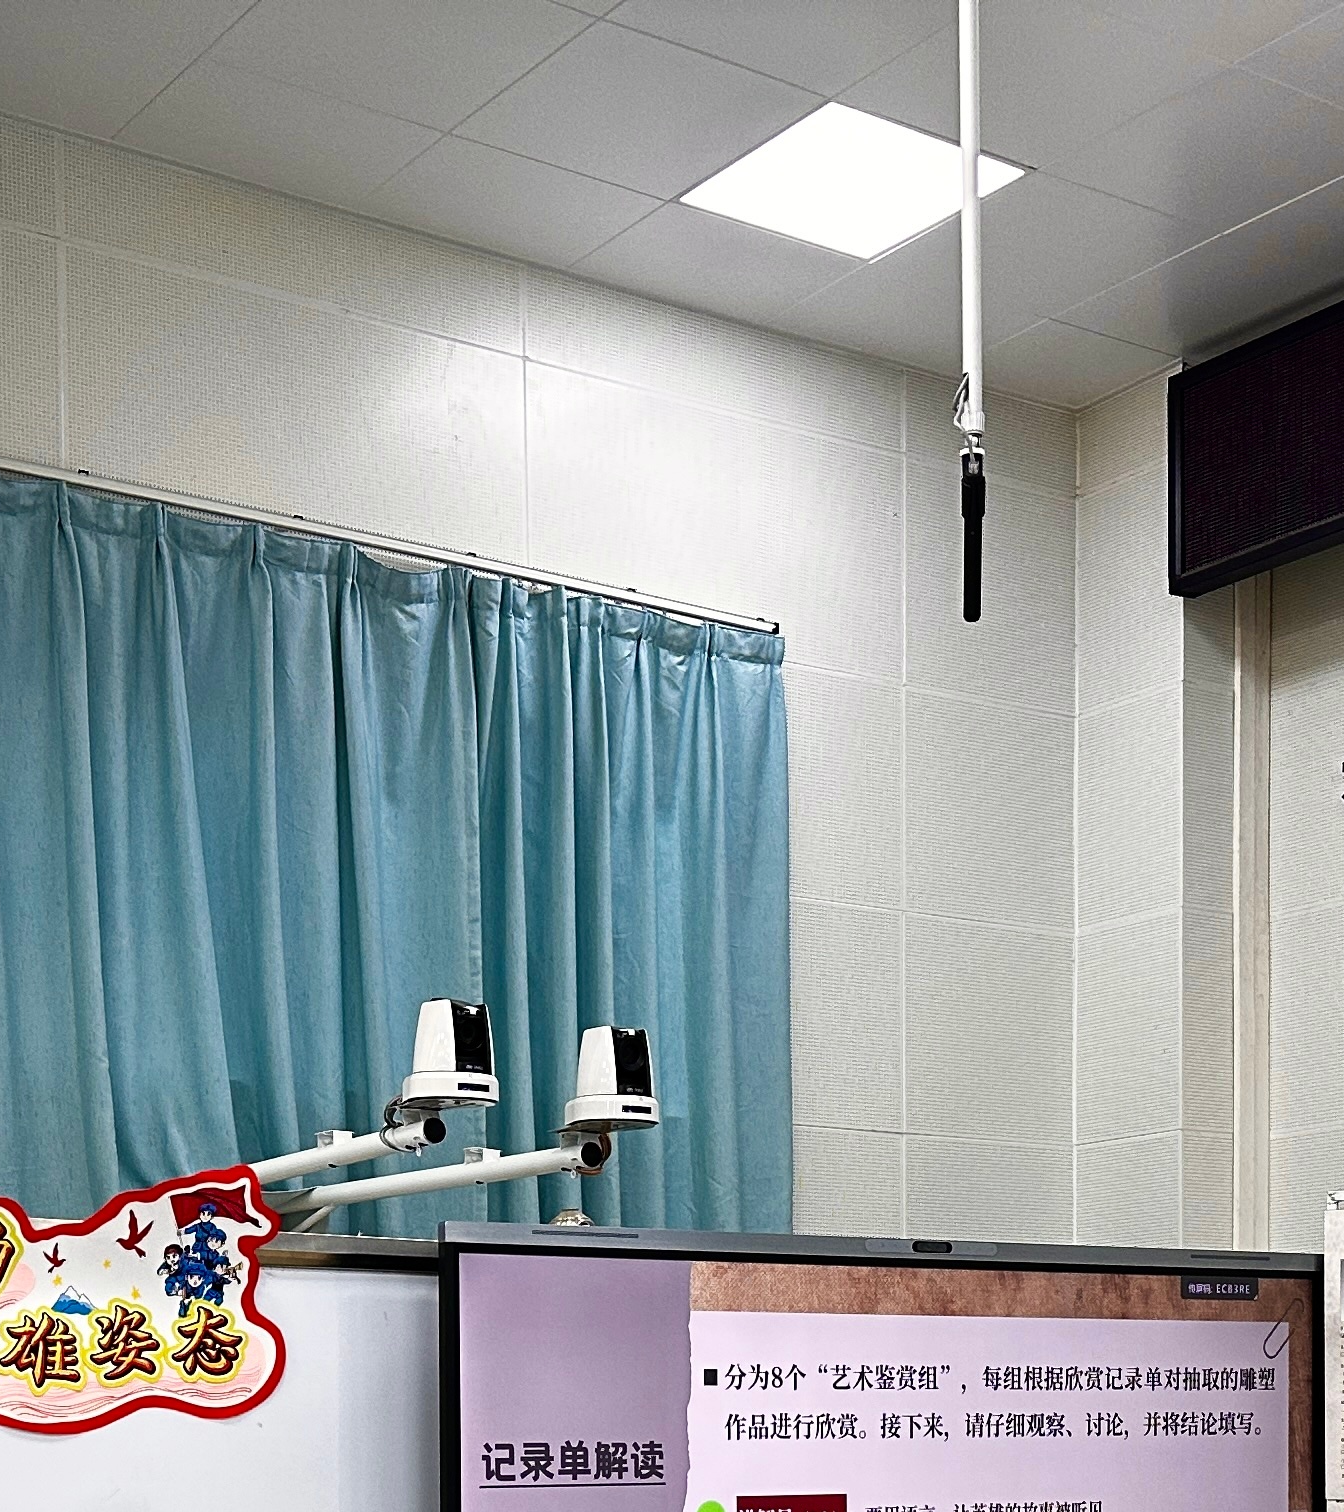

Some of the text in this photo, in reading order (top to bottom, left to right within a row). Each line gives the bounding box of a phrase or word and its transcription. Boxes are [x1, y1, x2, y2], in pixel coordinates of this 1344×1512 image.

[482, 1440, 665, 1482] 记录单解读
